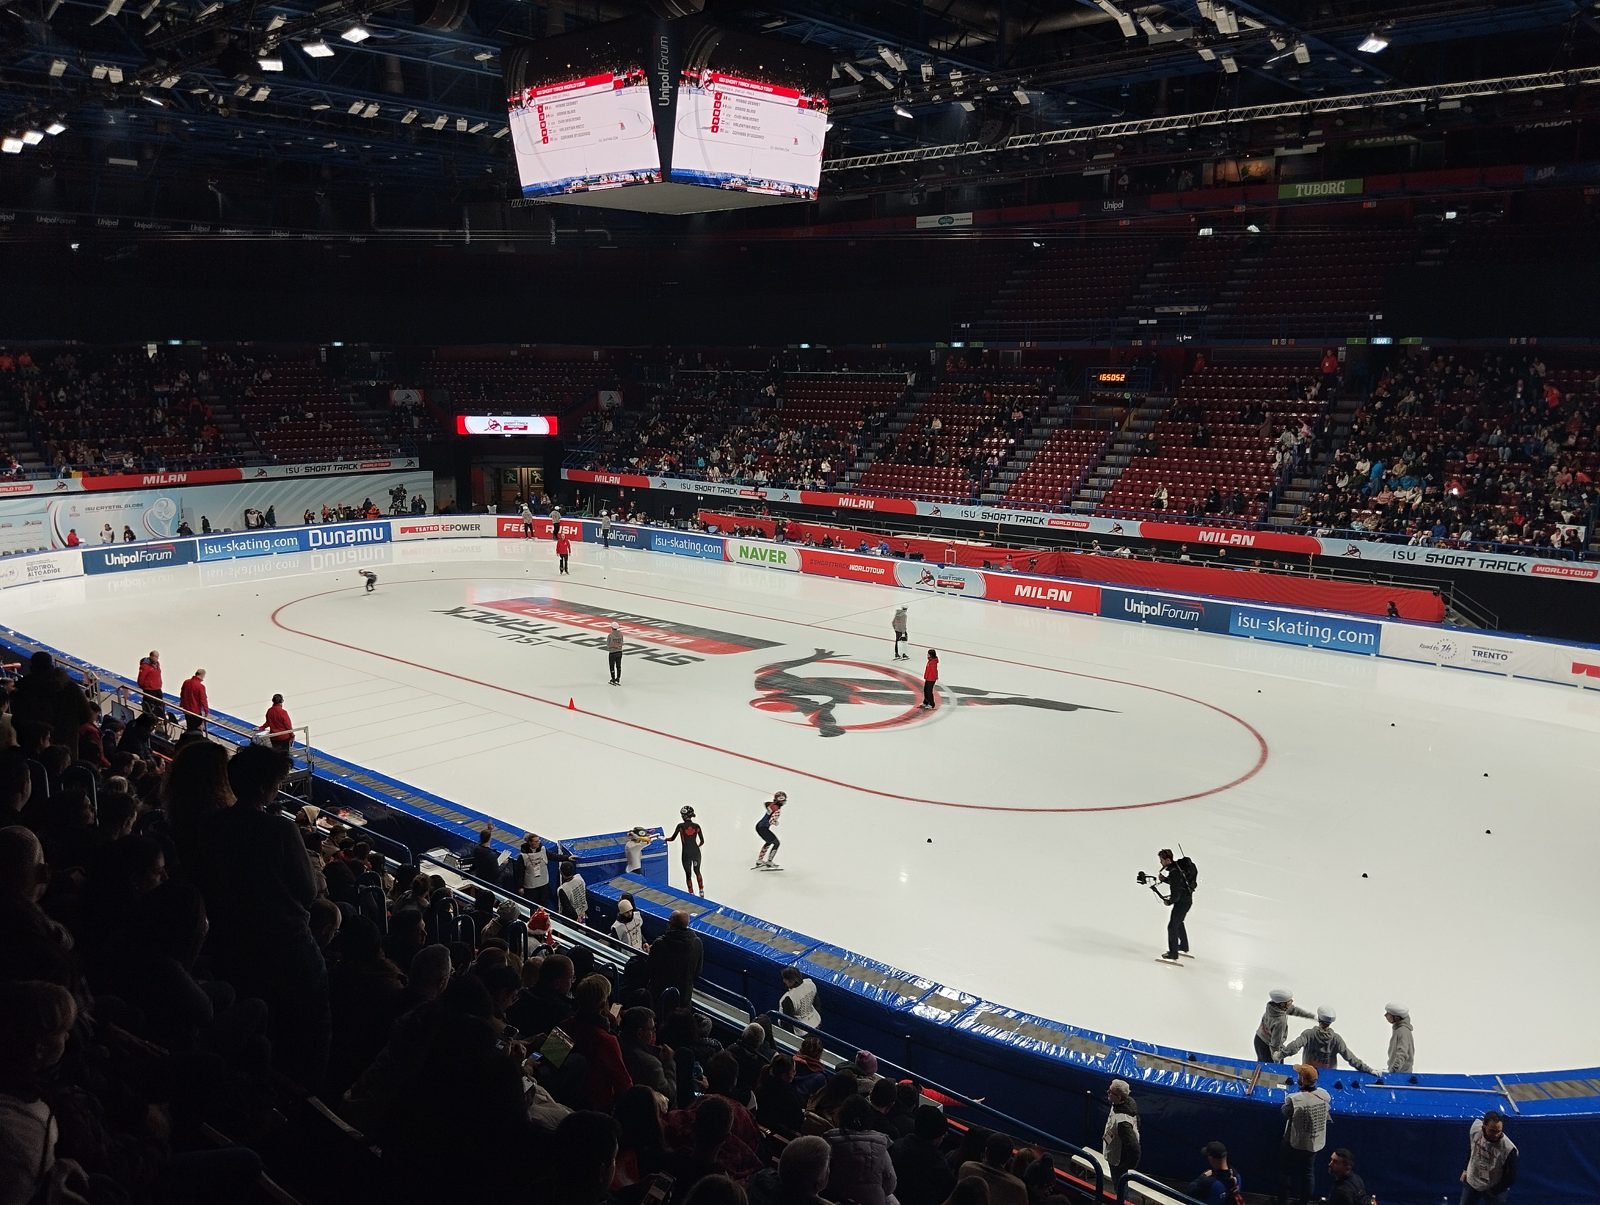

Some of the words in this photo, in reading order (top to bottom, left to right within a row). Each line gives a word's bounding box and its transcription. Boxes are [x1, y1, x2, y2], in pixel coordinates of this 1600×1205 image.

[658, 36, 674, 106] UnipolForum
[1295, 180, 1345, 197] TUBORG
[1103, 200, 1124, 211] Unipol
[304, 464, 332, 473] SHORT
[334, 463, 358, 472] TRACK
[142, 474, 187, 484] MILAN
[594, 474, 621, 485] MILAN
[680, 481, 691, 490] ISU
[694, 484, 717, 494] SHORT
[717, 486, 739, 496] TRACK
[838, 497, 875, 509] MILAN
[961, 510, 976, 519] ISU
[981, 512, 1013, 522] SHORT
[1015, 515, 1045, 525] TRACK
[439, 523, 481, 532] REPOWER
[204, 536, 299, 554] isu-skating.com
[309, 527, 384, 547] Dunamu
[655, 534, 722, 555] isu-skating.com
[1198, 531, 1256, 546] MILAN
[105, 550, 173, 567] UnipolForum
[739, 545, 787, 564] NAVER
[1392, 550, 1416, 561] ISU
[1425, 553, 1475, 567] SHORT
[1478, 559, 1528, 573] TRACK
[1536, 565, 1568, 575] WORLD
[1569, 568, 1595, 577] TOUR
[1015, 584, 1073, 603] MILAN
[1124, 597, 1200, 621] UnipolForum
[1237, 612, 1375, 645] isu-skating.com
[1472, 649, 1508, 661] TRENTO
